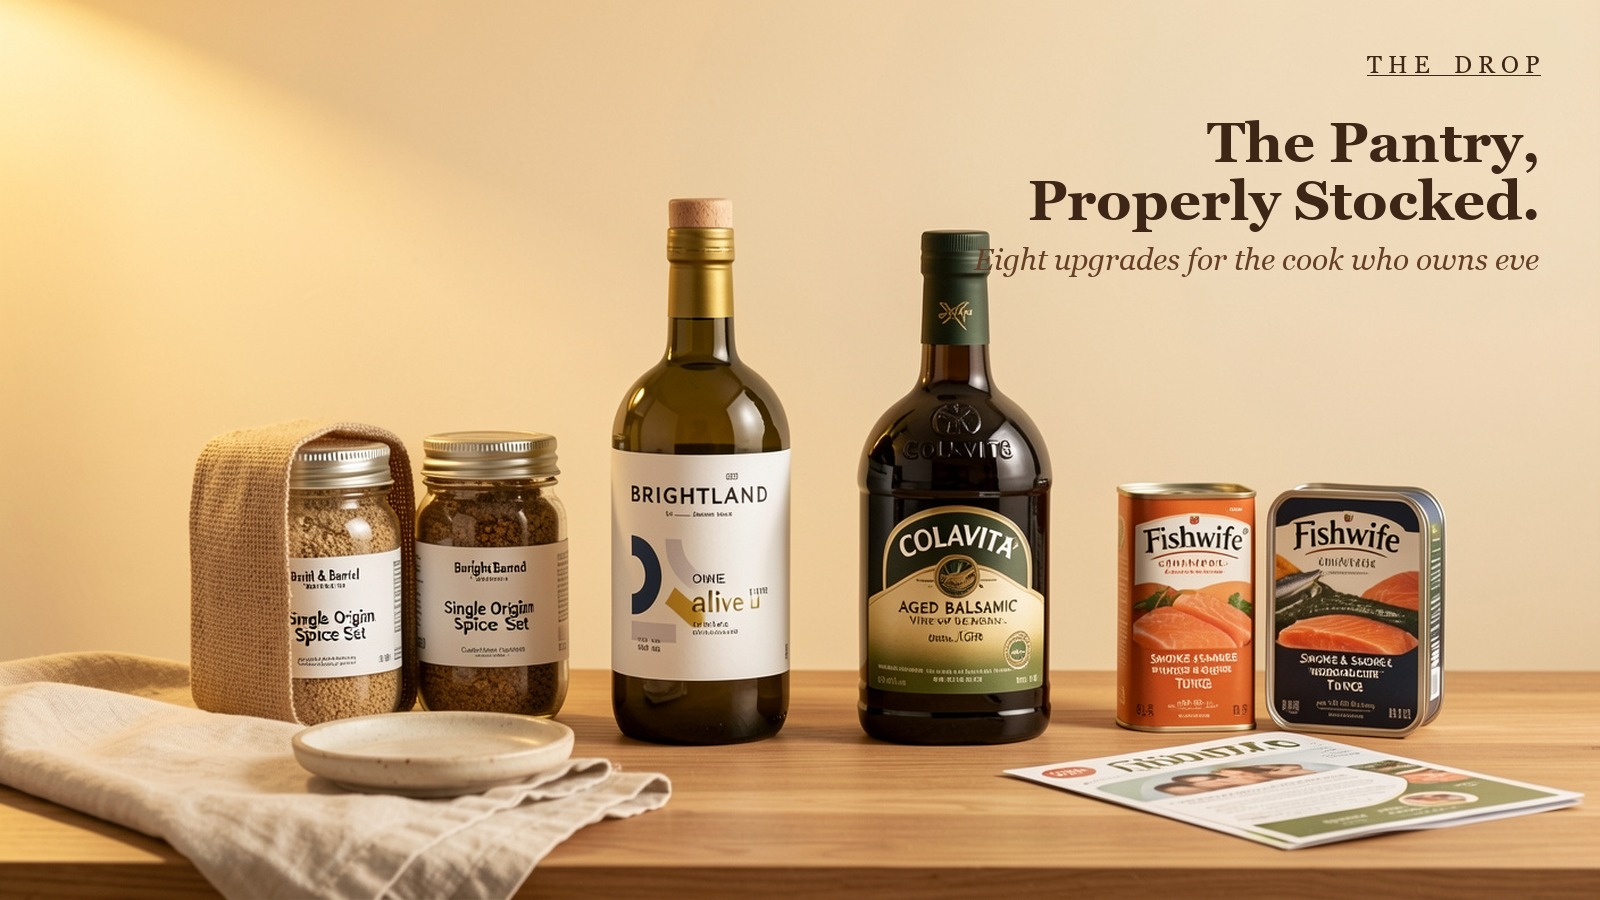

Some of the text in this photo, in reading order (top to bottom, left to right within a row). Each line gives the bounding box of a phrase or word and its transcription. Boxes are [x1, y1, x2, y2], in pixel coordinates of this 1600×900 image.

[631, 485, 768, 505] BRIGHTLAND
[1293, 519, 1400, 553] Fishwife
[444, 600, 487, 619] Single
[691, 590, 744, 613] alive
[899, 599, 1018, 614] AGED BALSAMIC
[343, 626, 366, 641] Set
[454, 617, 530, 635] Spice Set
